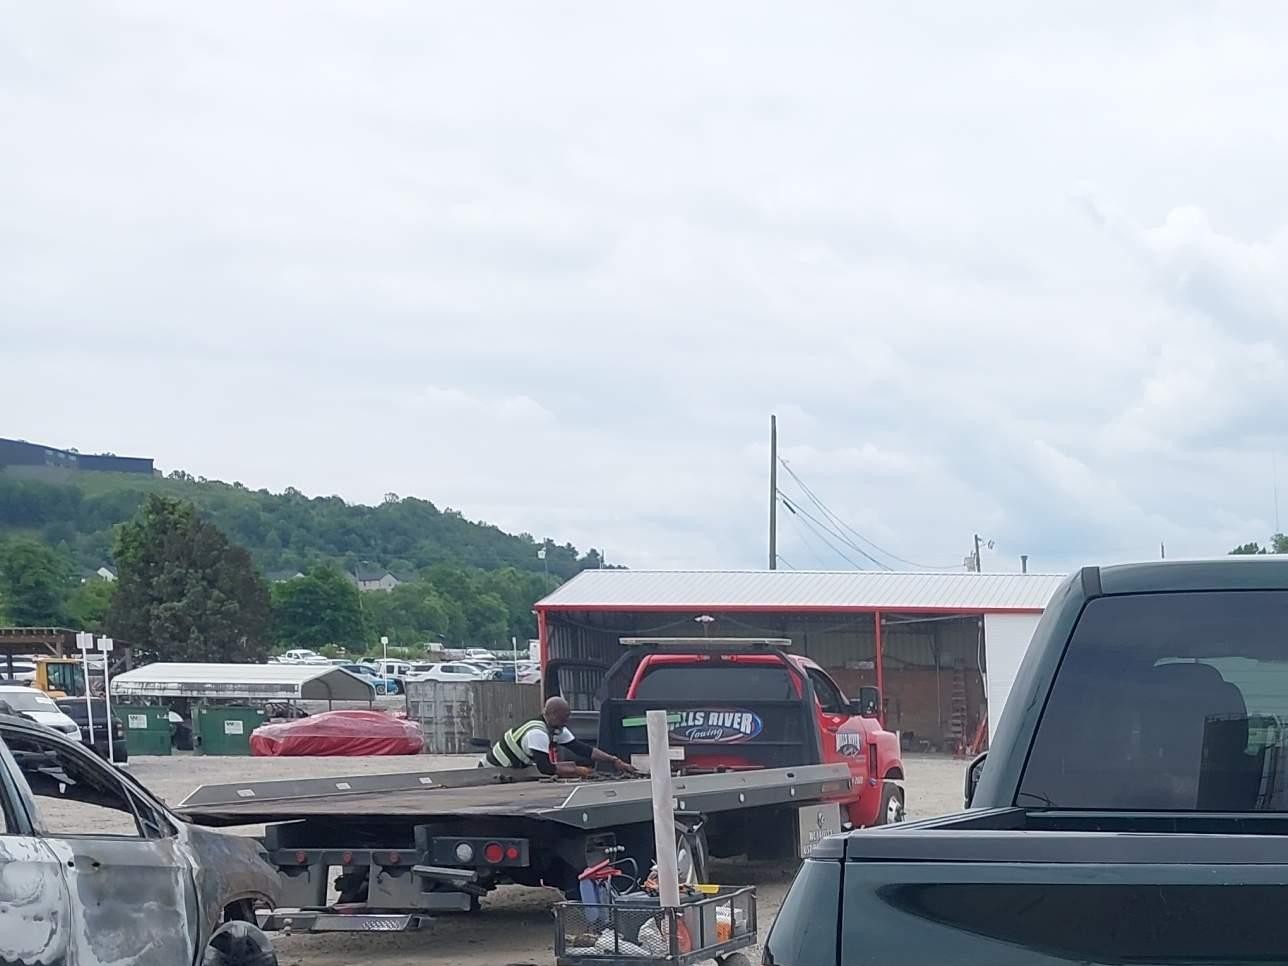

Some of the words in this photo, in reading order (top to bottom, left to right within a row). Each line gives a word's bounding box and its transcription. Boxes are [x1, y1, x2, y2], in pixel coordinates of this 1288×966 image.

[668, 711, 705, 731] LLS
[708, 711, 753, 735] RIVER
[685, 726, 723, 743] Towing
